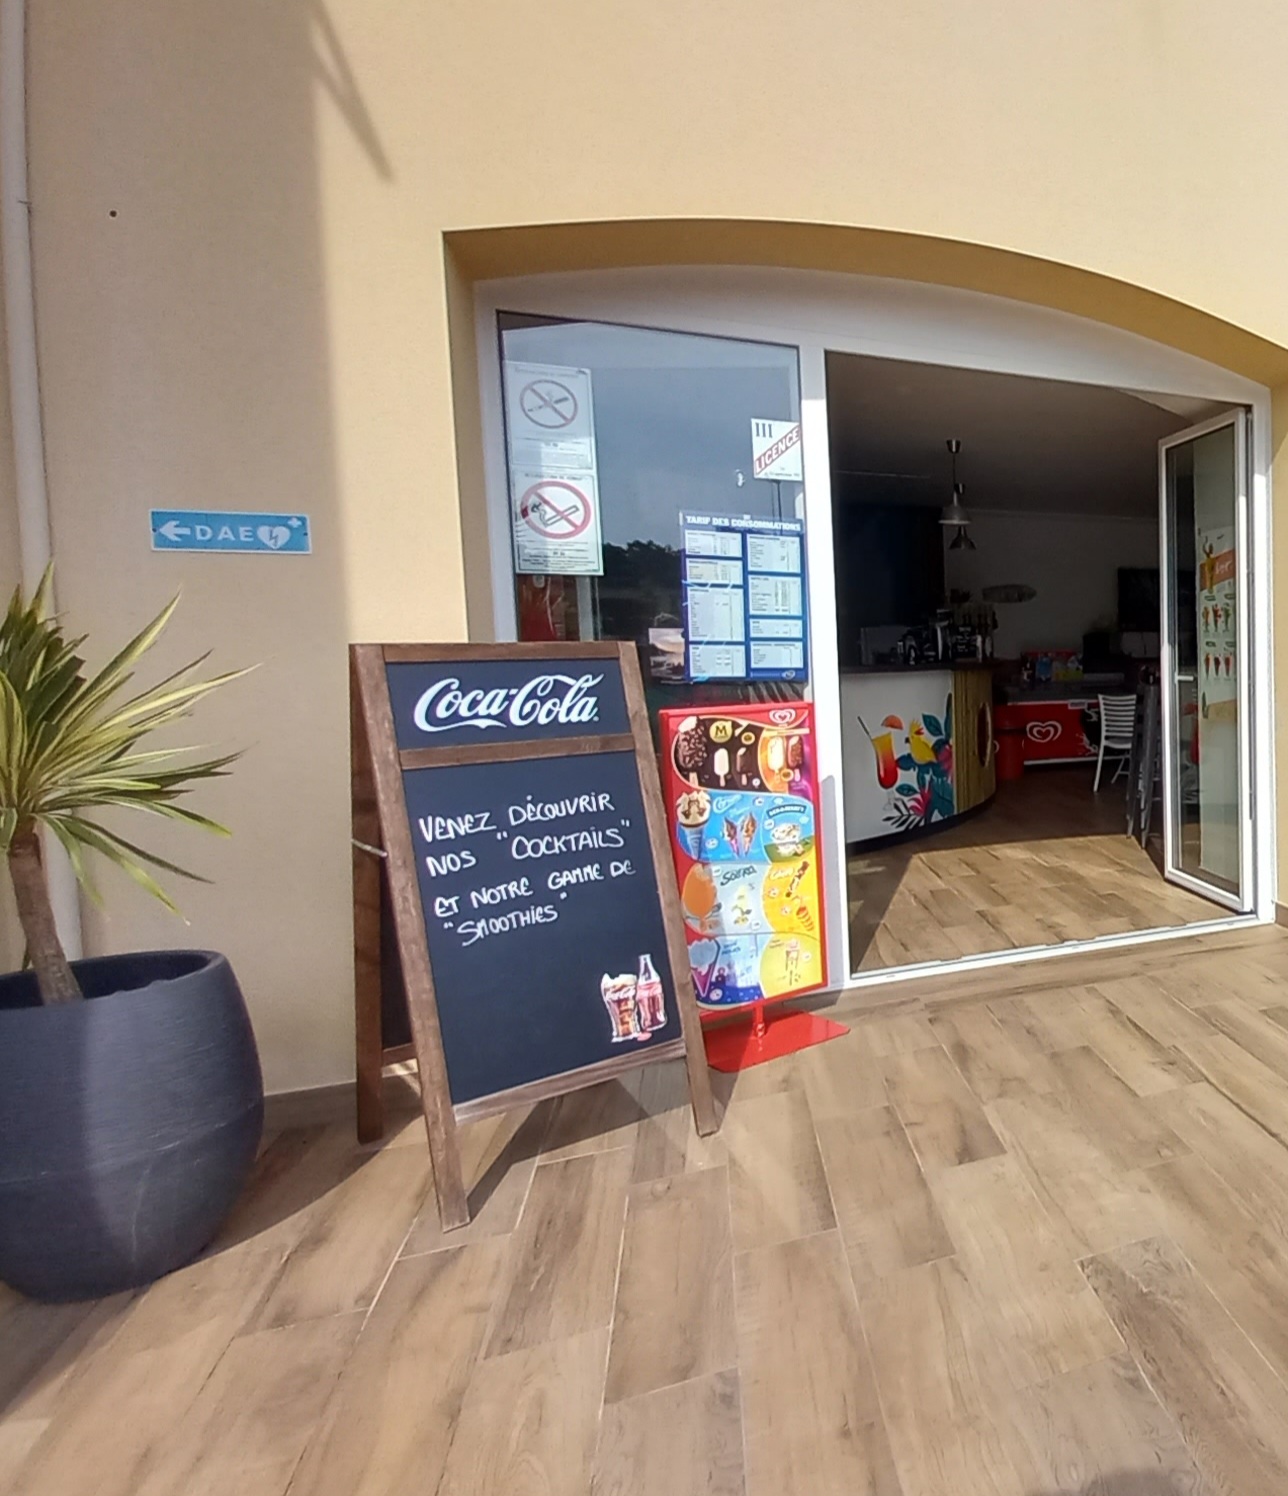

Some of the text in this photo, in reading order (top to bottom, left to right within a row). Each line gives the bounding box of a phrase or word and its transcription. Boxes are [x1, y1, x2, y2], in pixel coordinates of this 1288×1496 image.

[755, 422, 773, 438] III
[755, 428, 800, 474] LICENCE
[195, 525, 254, 541] DAE
[685, 515, 801, 532] TARIF DES CONSOMMATIONS
[414, 673, 605, 732] Coca-Cola
[419, 811, 497, 843] VENEZ
[426, 850, 477, 877] NOS
[434, 859, 636, 918] ET NOTRE GAMME DE
